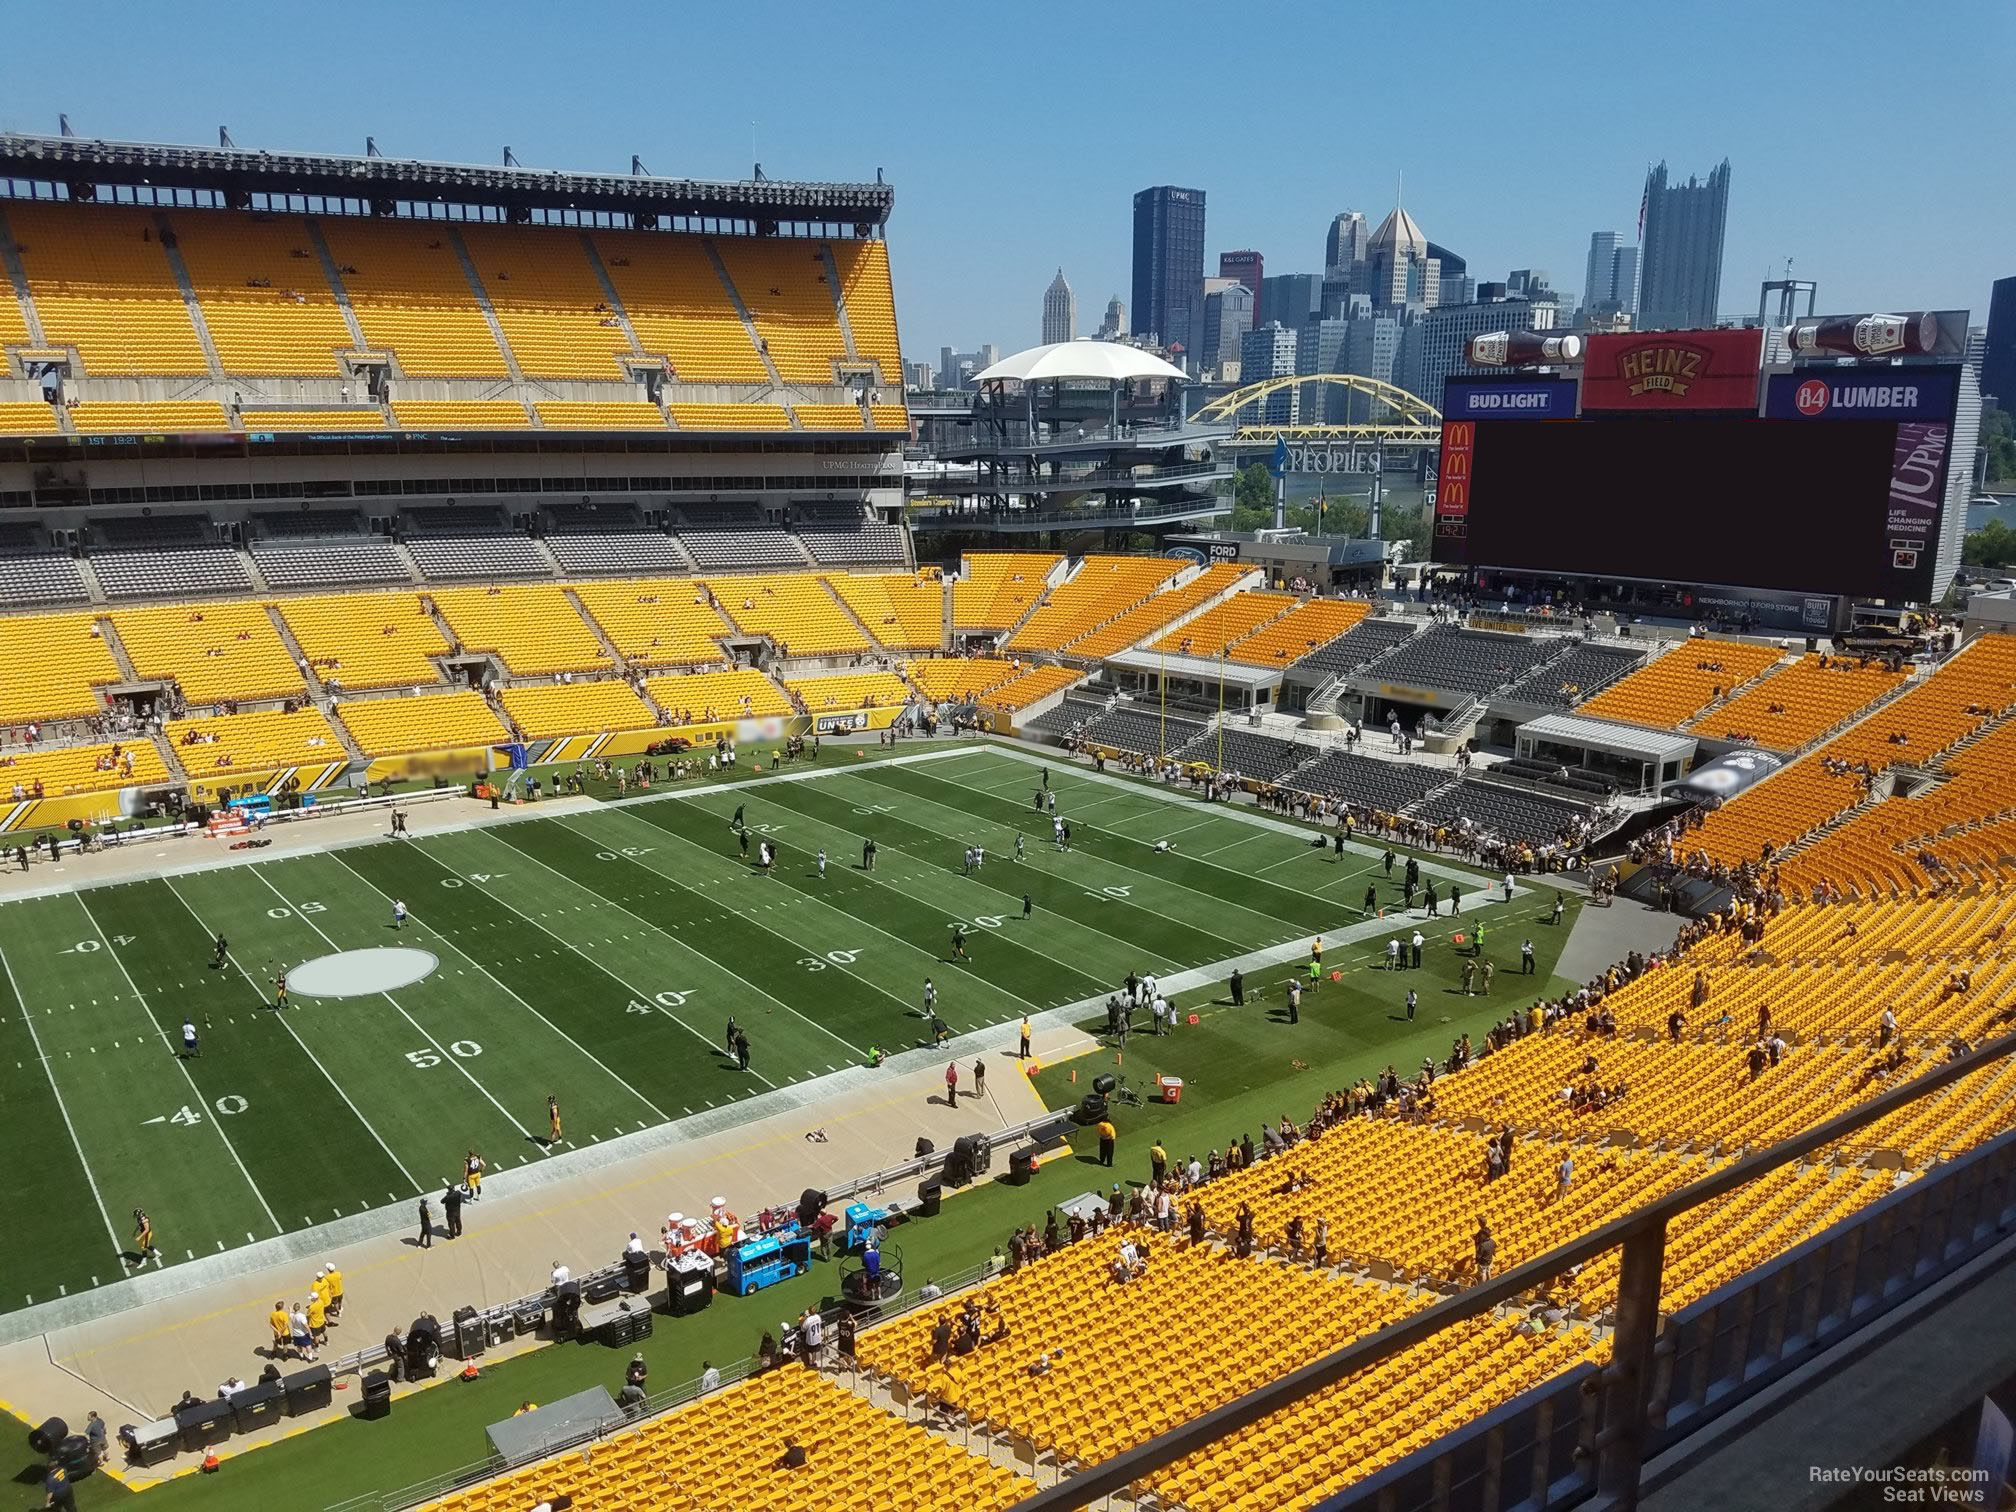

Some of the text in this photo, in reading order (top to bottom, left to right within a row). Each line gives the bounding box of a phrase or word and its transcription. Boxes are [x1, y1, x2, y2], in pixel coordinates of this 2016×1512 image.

[1171, 191, 1190, 200] UPMC
[1858, 323, 1869, 346] HEINZ
[1622, 348, 1701, 380] HEINZ
[1646, 377, 1670, 388] FIELD
[1469, 393, 1548, 408] BUD LIGHT
[1799, 386, 1918, 408] 84 LUMBER
[822, 461, 849, 469] UPMC
[1289, 448, 1380, 475] PEOPLES
[1890, 428, 1947, 494] UPMC
[1887, 517, 1932, 525] CHANGING
[1887, 524, 1927, 533] MEDICINE
[1209, 545, 1236, 557] FORD
[1209, 556, 1229, 565] FAN
[1776, 604, 1800, 613] STORE
[1806, 602, 1827, 611] BUILT
[1469, 617, 1483, 628] LIVE
[1484, 619, 1508, 632] UNITED
[1805, 617, 1826, 625] TOUGH
[811, 1322, 820, 1337] 91
